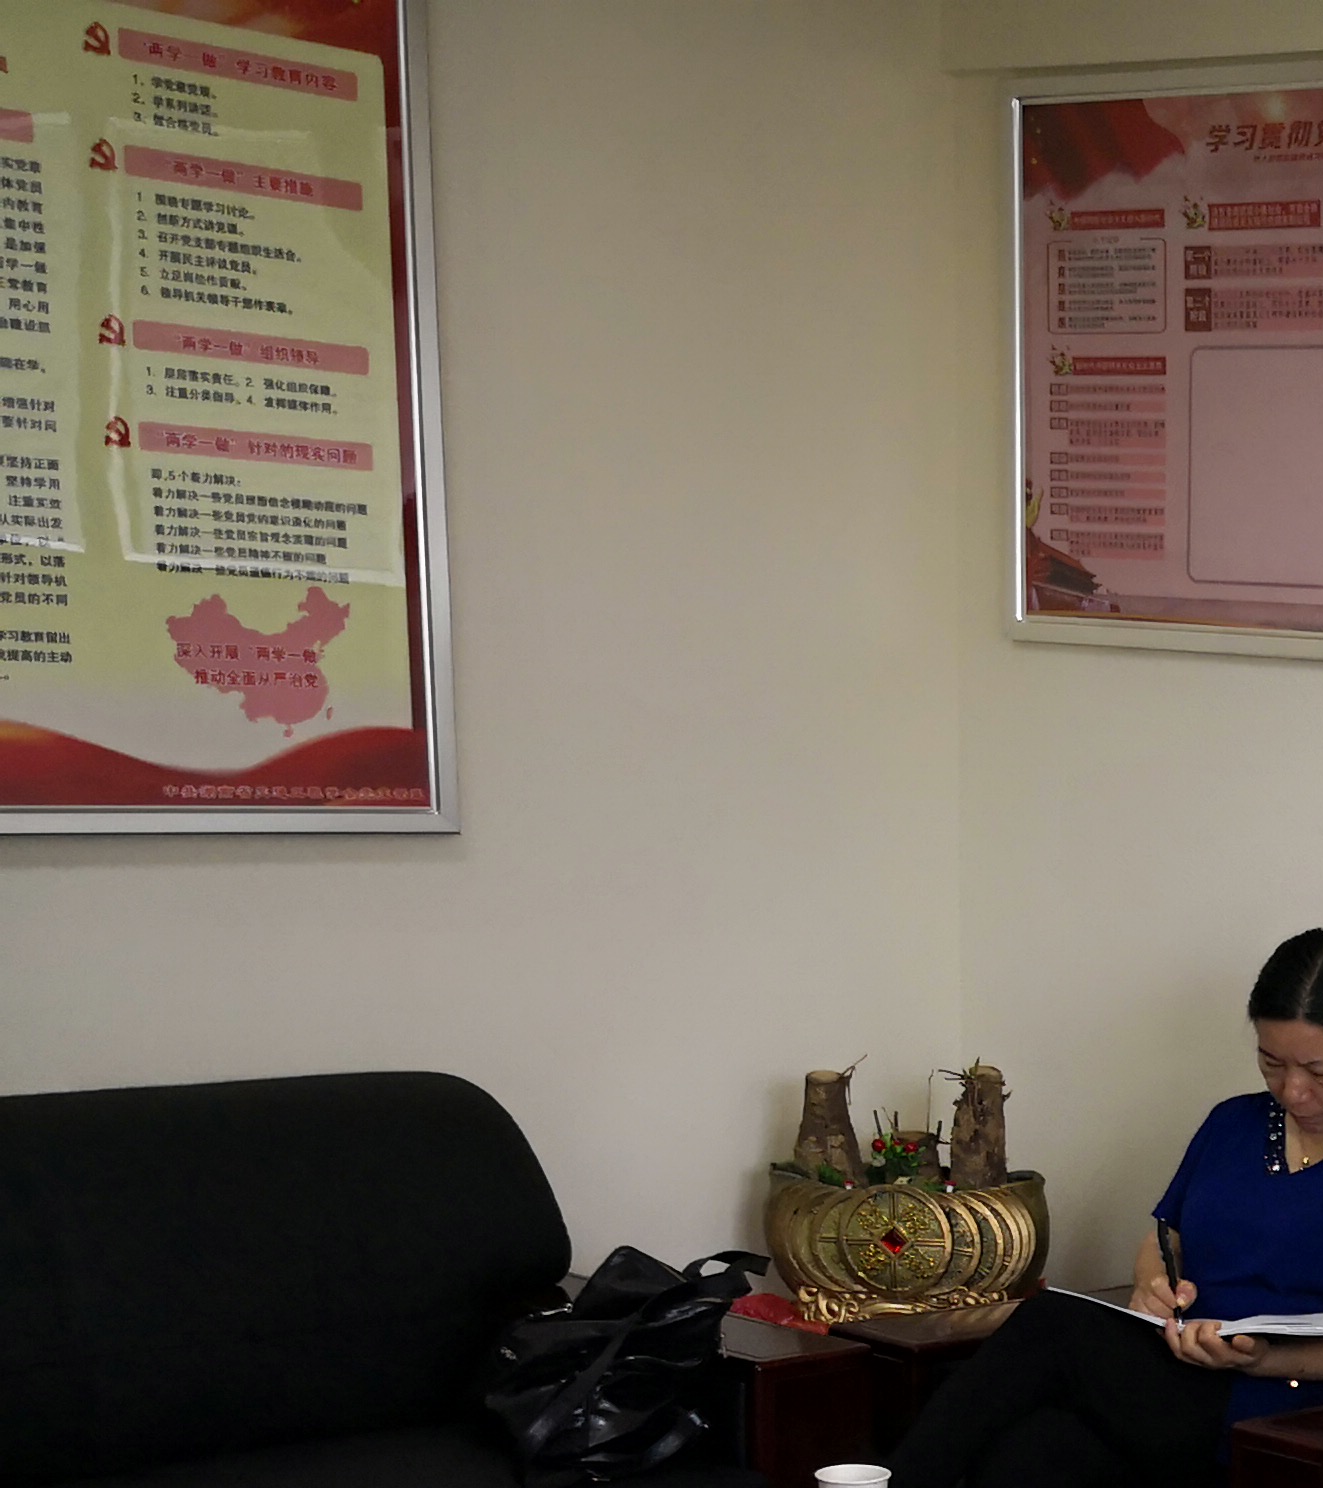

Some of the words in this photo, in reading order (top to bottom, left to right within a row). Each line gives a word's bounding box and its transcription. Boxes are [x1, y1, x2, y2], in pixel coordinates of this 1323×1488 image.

[236, 58, 337, 91] 学习教育内容
[176, 643, 239, 660] 深入开展
[195, 670, 318, 688] 推动全面从严治党
